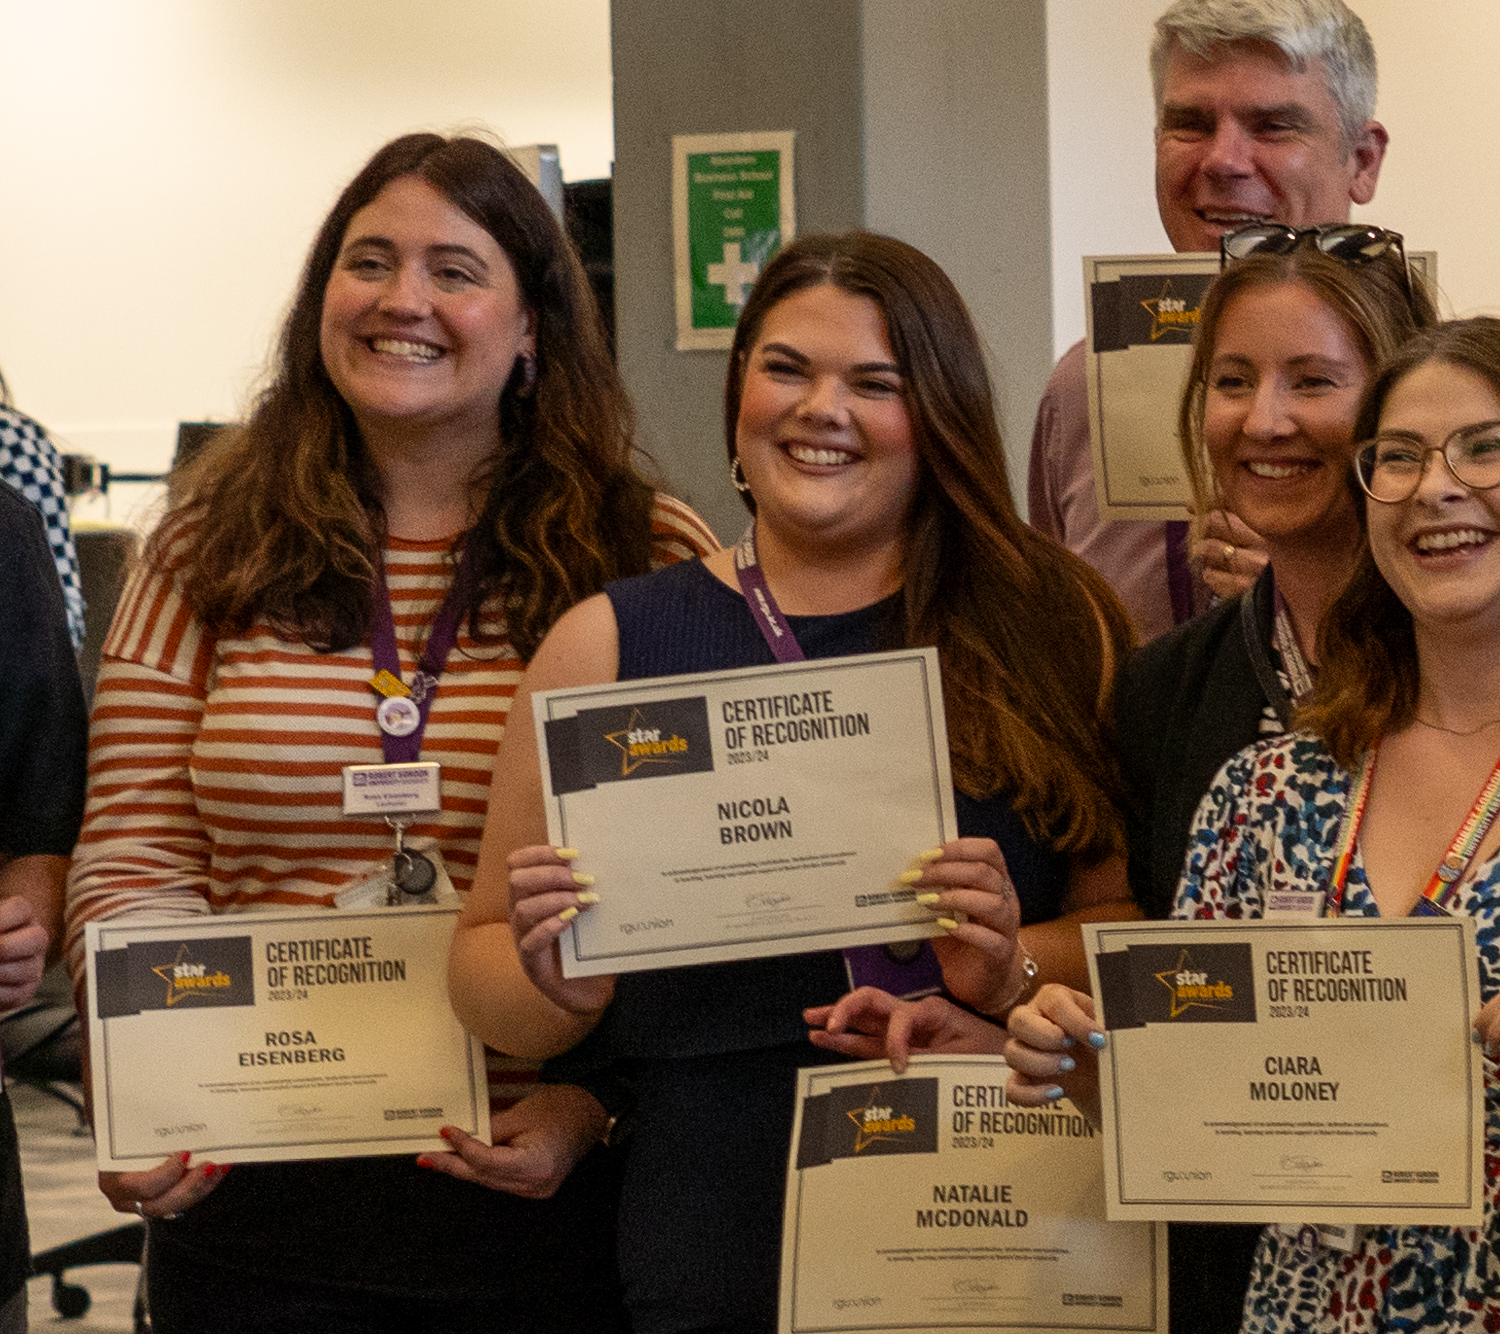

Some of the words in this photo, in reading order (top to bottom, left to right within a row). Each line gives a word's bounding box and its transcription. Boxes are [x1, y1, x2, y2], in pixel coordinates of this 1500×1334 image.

[1158, 307, 1200, 324] award
[722, 690, 833, 724] CERTIFICATE
[628, 727, 661, 743] star
[725, 727, 749, 749] OF
[753, 713, 870, 746] RECOGNITION
[629, 737, 688, 756] awards
[717, 796, 790, 821] NICOLA
[720, 821, 792, 844] BROWN
[266, 936, 373, 963] CERTIFICATE
[174, 963, 206, 977] star
[1266, 951, 1372, 975] CERTIFICATE
[174, 973, 231, 988] awards
[268, 966, 291, 988] OF
[294, 960, 406, 987] RECOGNITION
[1176, 970, 1208, 985] star
[1177, 983, 1233, 999] awards
[1268, 979, 1288, 1002] OF
[1294, 978, 1407, 1002] RECOGNITION
[265, 1030, 317, 1047] ROSA
[238, 1048, 346, 1067] EISENBERG
[1265, 1056, 1322, 1076] CIARA
[1250, 1082, 1340, 1102] MOLONEY
[864, 1105, 892, 1121] star
[863, 1116, 915, 1133] awards
[952, 1112, 976, 1134] OF
[980, 1112, 1095, 1138] RECOGNITION
[933, 1185, 1012, 1204] NATALIE
[916, 1210, 1028, 1228] MCDONALD
